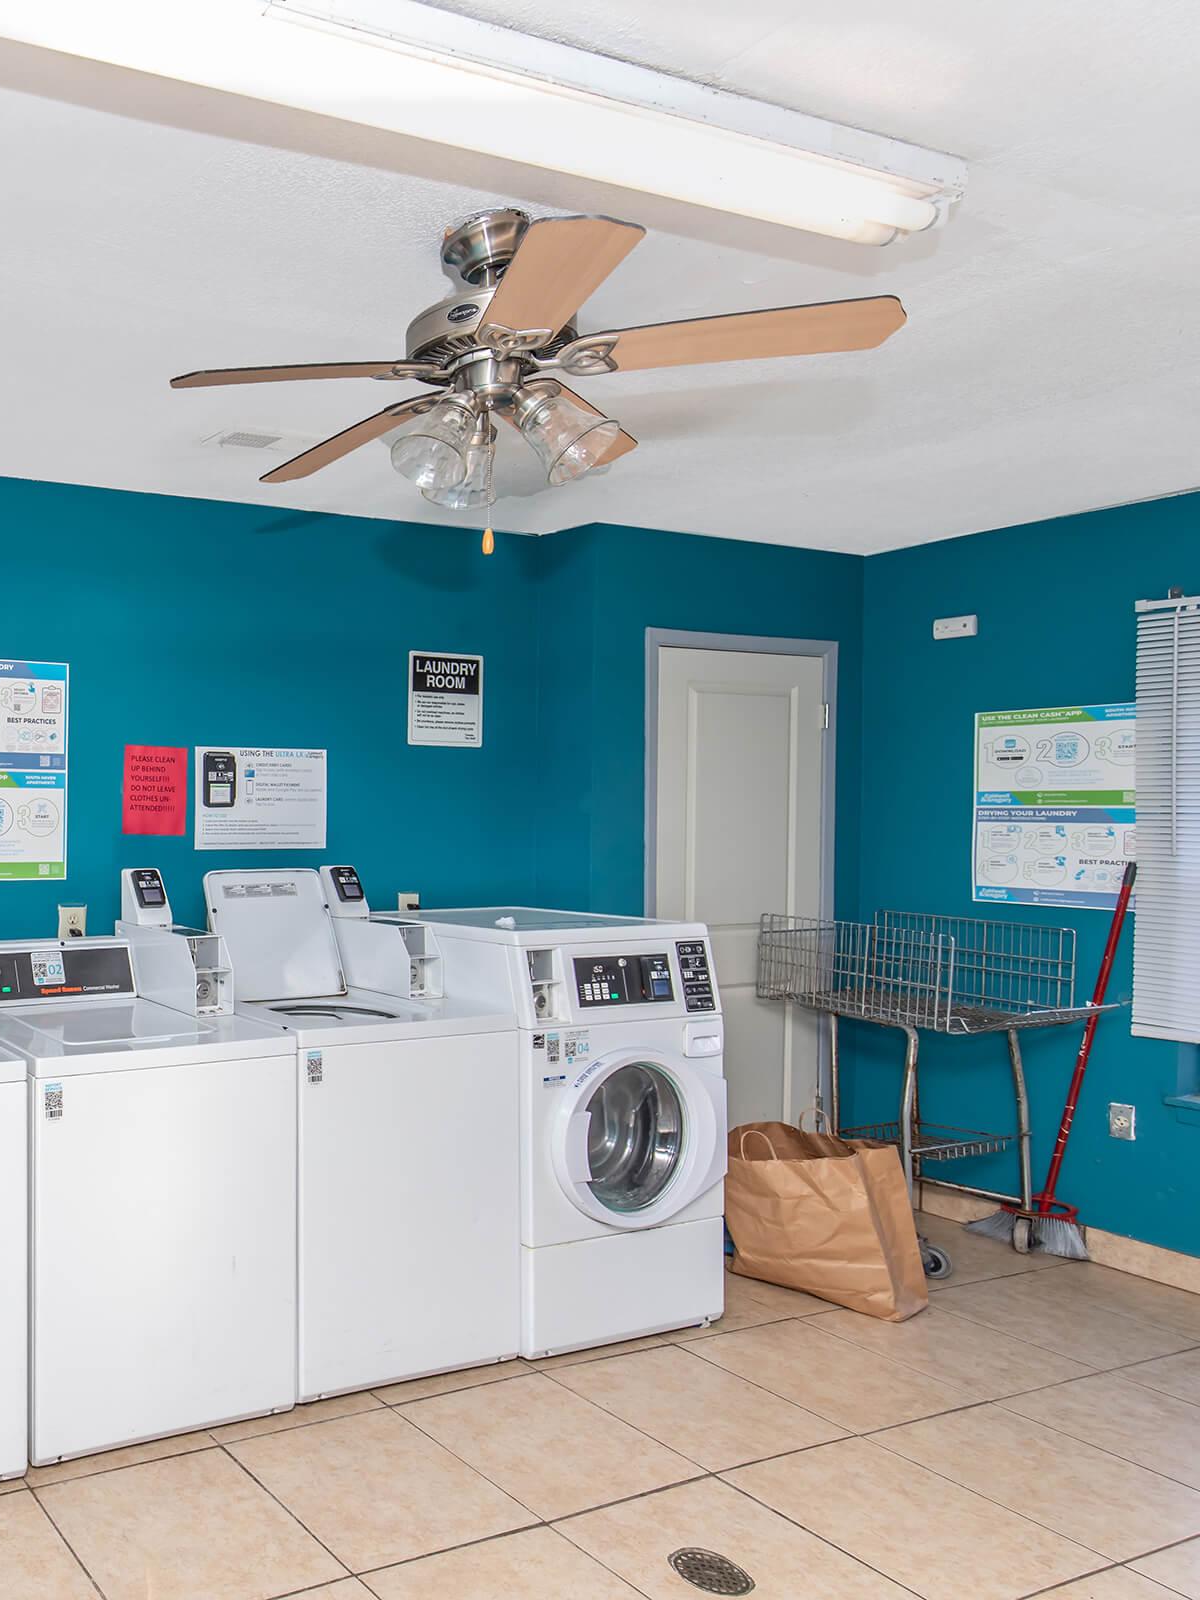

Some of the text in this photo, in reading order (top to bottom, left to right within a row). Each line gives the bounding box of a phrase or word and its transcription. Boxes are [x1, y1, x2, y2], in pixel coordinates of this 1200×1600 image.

[416, 660, 476, 676] LAUNDRY
[426, 674, 466, 689] ROOM
[48, 964, 62, 975] 02
[577, 1042, 590, 1054] 04
